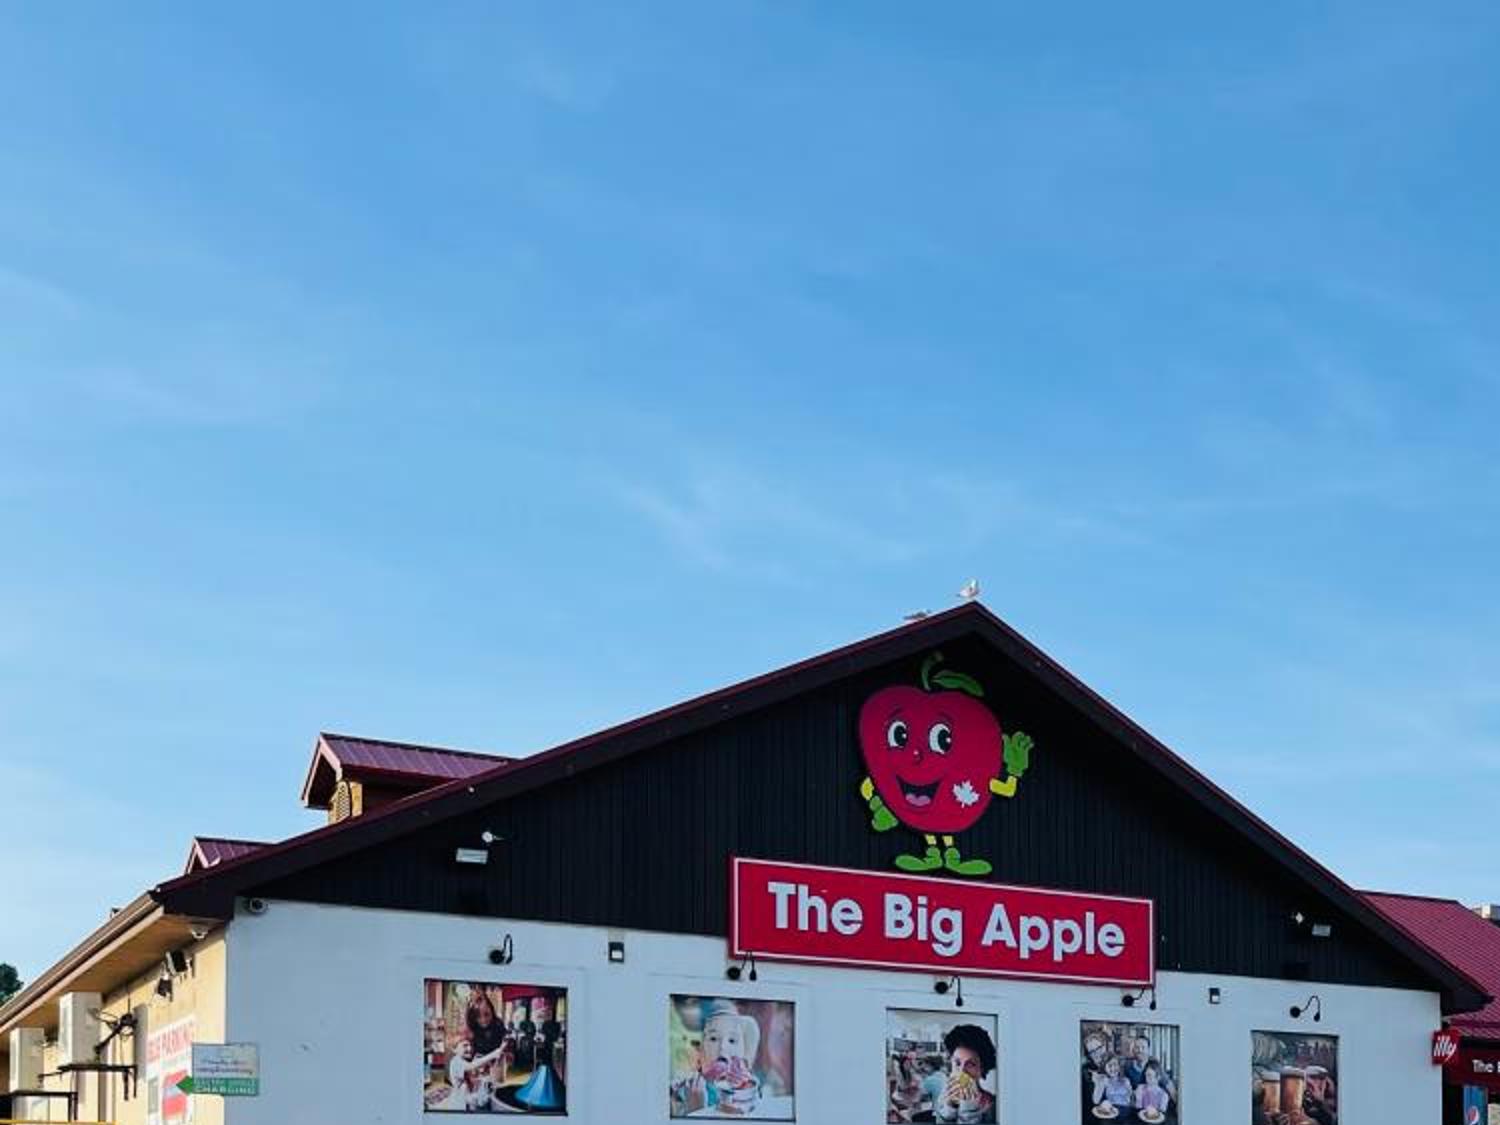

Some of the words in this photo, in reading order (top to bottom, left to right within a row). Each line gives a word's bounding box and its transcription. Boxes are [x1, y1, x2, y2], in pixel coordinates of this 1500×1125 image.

[768, 881, 863, 935] The
[884, 893, 963, 956] Big
[981, 903, 1125, 962] Apple
[1433, 1035, 1457, 1063] illy
[1473, 1059, 1493, 1073] The
